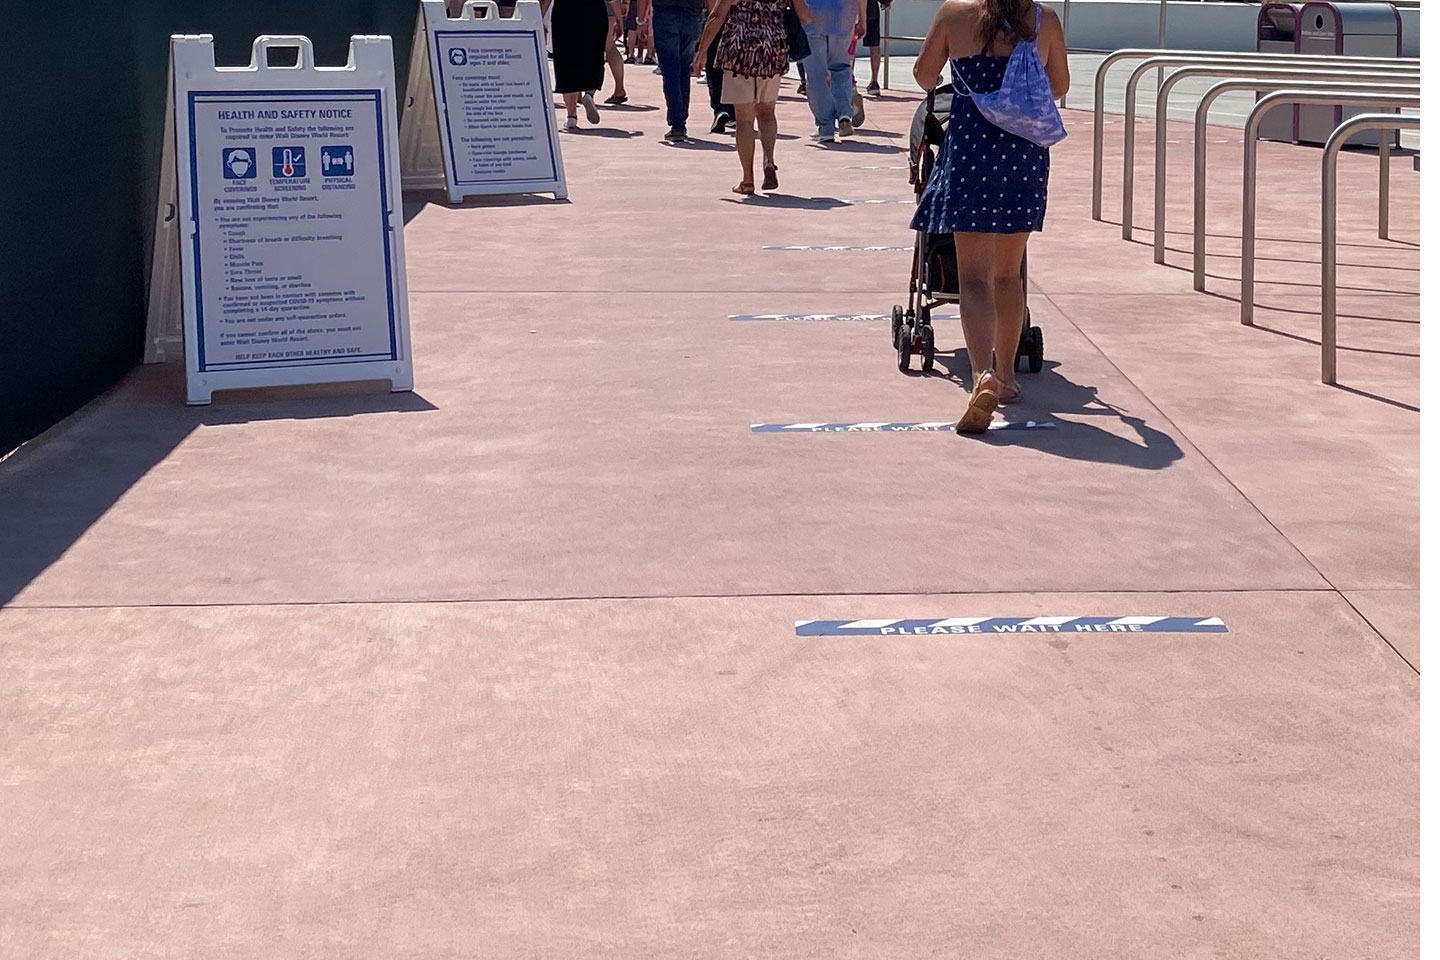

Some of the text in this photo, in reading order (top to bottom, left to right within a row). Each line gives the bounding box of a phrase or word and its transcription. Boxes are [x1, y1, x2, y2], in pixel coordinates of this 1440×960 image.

[218, 109, 352, 120] HEALTH AND SAFETY NOTICE
[880, 624, 1144, 635] PLEASE WAIT HERE
